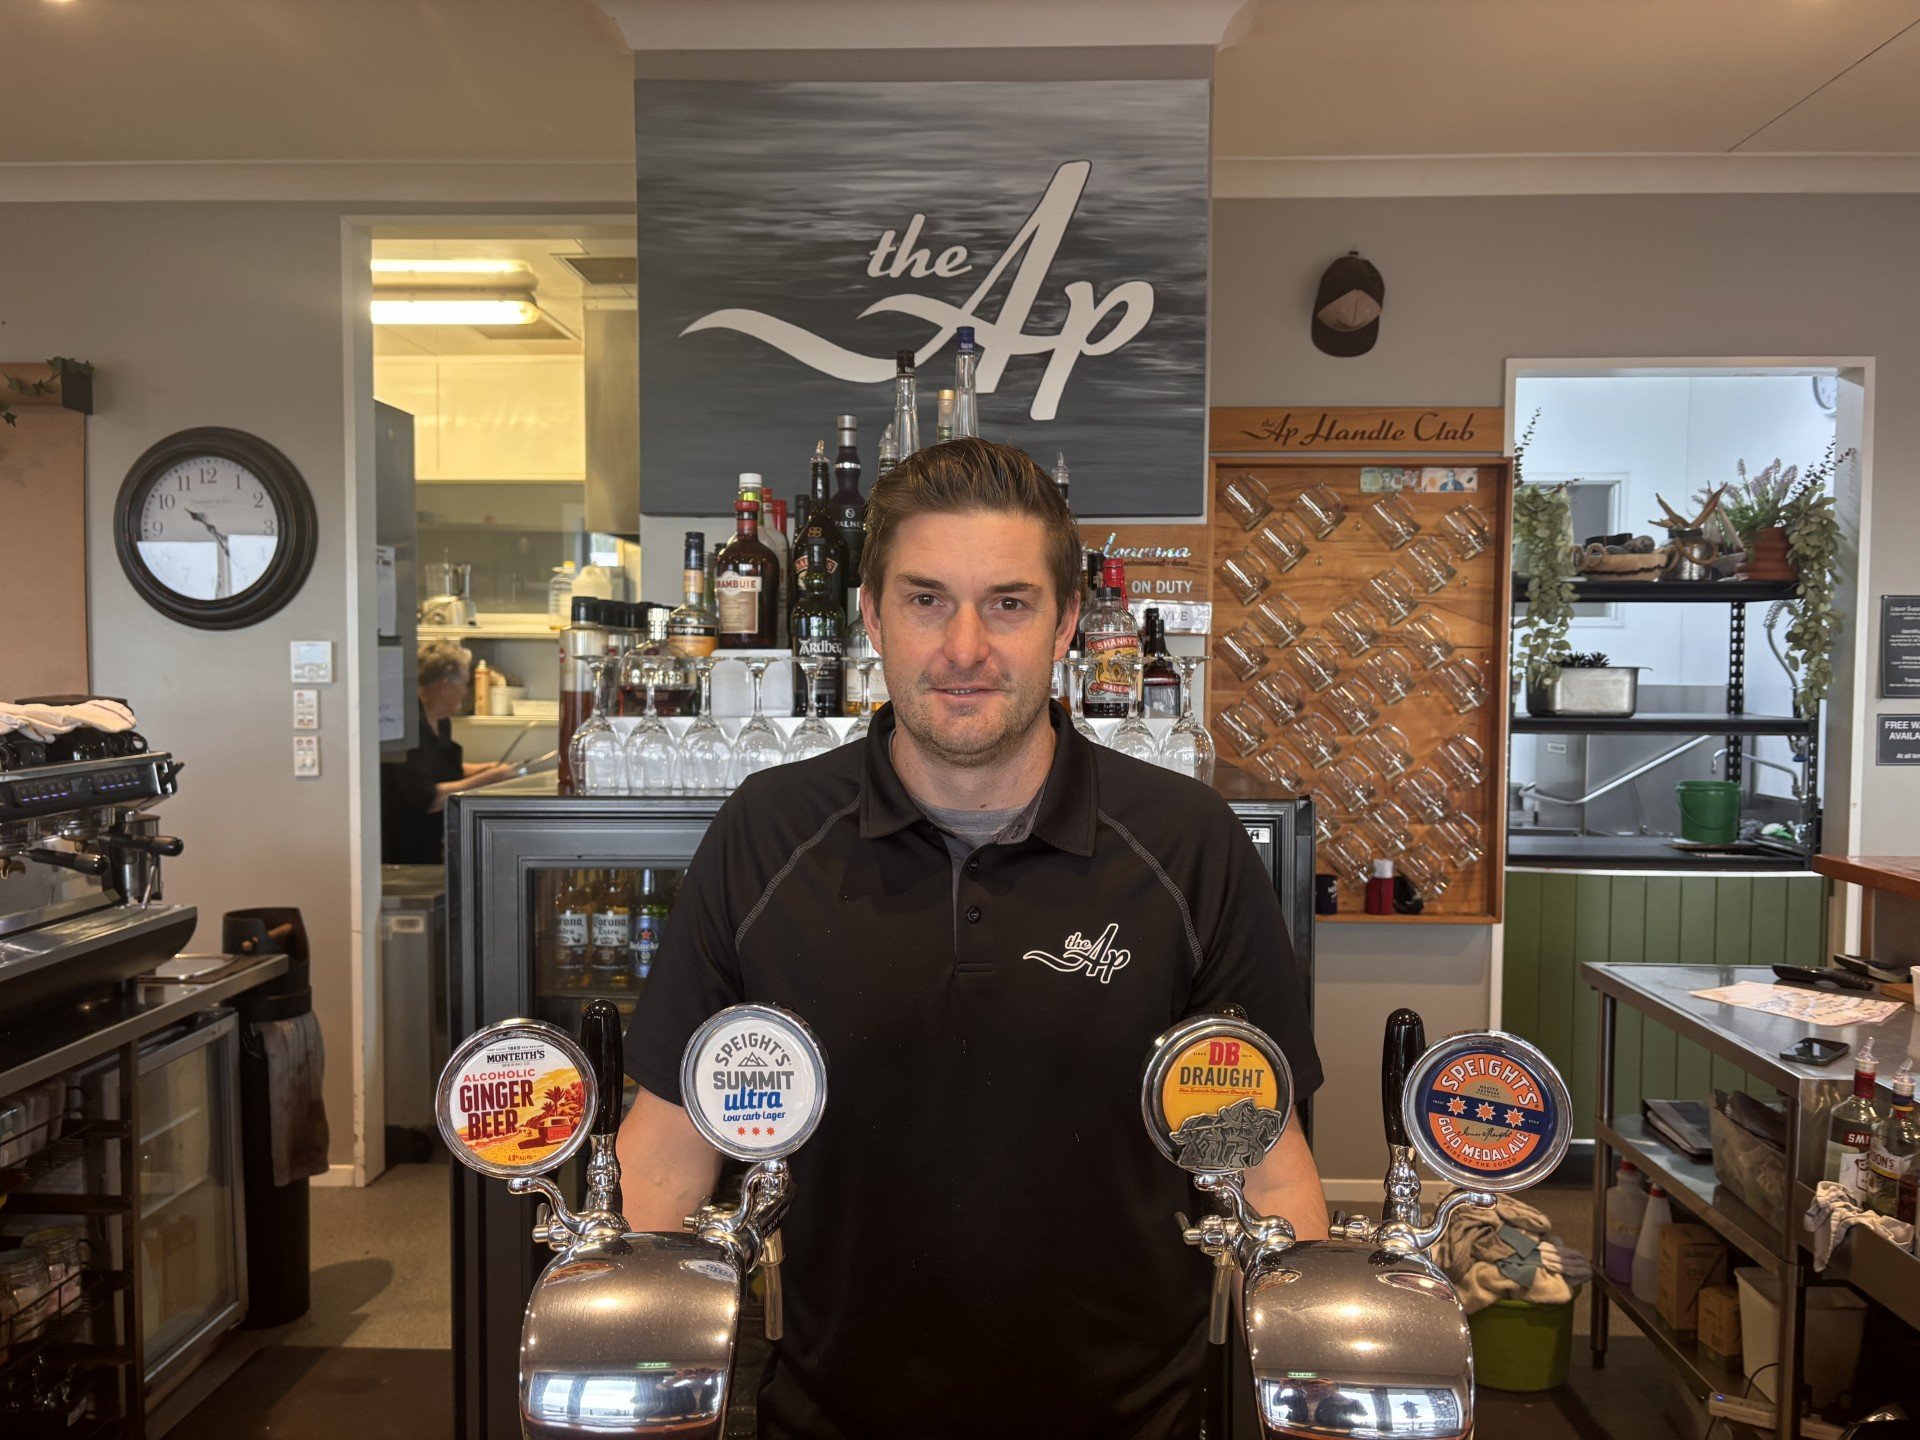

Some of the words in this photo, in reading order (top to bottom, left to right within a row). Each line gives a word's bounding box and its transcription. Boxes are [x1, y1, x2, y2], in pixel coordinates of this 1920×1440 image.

[867, 213, 973, 279] the
[678, 160, 1154, 421] Ap
[1241, 413, 1299, 446] Ap
[1299, 413, 1405, 447] Handle
[1413, 412, 1475, 442] Club
[178, 475, 191, 491] 11
[200, 466, 217, 484] 12
[236, 474, 241, 490] 1
[159, 493, 175, 510] 10
[253, 492, 264, 508] 2
[153, 520, 163, 536] 9
[264, 519, 275, 536] 3
[716, 580, 757, 588] RAMBUIE
[1131, 580, 1151, 594] ON
[1156, 580, 1193, 594] DUTY
[1097, 636, 1137, 650] SHANKY'S
[1102, 683, 1122, 692] MADE
[1885, 720, 1910, 729] FREE
[1065, 932, 1092, 950] the
[1023, 923, 1131, 984] Ap
[486, 1050, 545, 1063] MONTEITH'S
[715, 1032, 791, 1067] SPEIGHT'S
[1209, 1041, 1241, 1067] DB
[463, 1068, 536, 1083] ALCOHOLIC
[713, 1070, 795, 1090] SUMMIT
[1179, 1066, 1265, 1088] DRAUGHT
[1441, 1058, 1538, 1106] SPEIGHT'S
[460, 1079, 534, 1113] GINGER
[724, 1086, 783, 1111] ultra
[467, 1109, 519, 1141] BEER
[723, 1113, 741, 1122] Low
[742, 1112, 761, 1121] carb
[762, 1111, 786, 1121] Lager
[1438, 1117, 1462, 1149] GOLD
[1461, 1143, 1509, 1161] MEDAL
[1508, 1132, 1529, 1154] ALE
[1443, 1142, 1460, 1159] PRIDE
[1493, 1157, 1517, 1167] SOUTH
